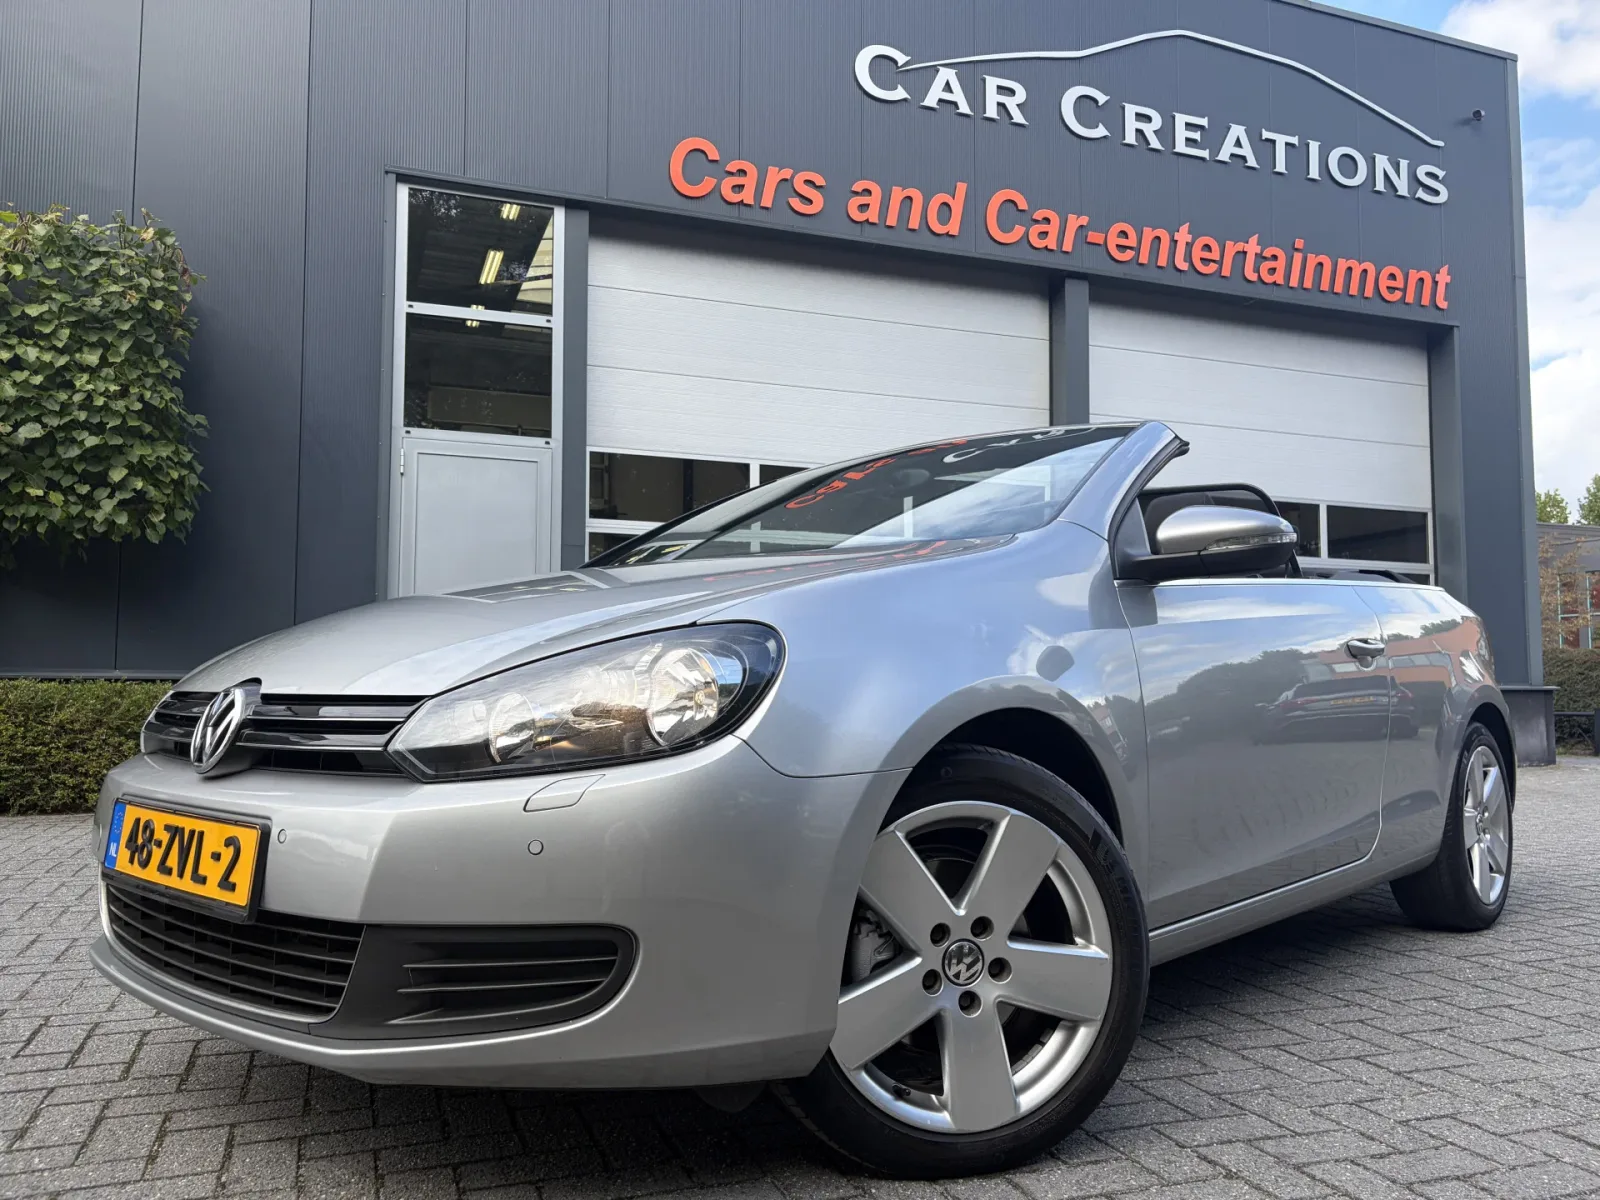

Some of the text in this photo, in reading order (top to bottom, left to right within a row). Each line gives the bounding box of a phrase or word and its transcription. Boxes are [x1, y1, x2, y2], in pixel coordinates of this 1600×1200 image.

[855, 45, 1449, 204] CAR CREATIONS
[669, 137, 1451, 309] Cars and Car-entertainment
[125, 816, 241, 893] 48-ZVL-2
